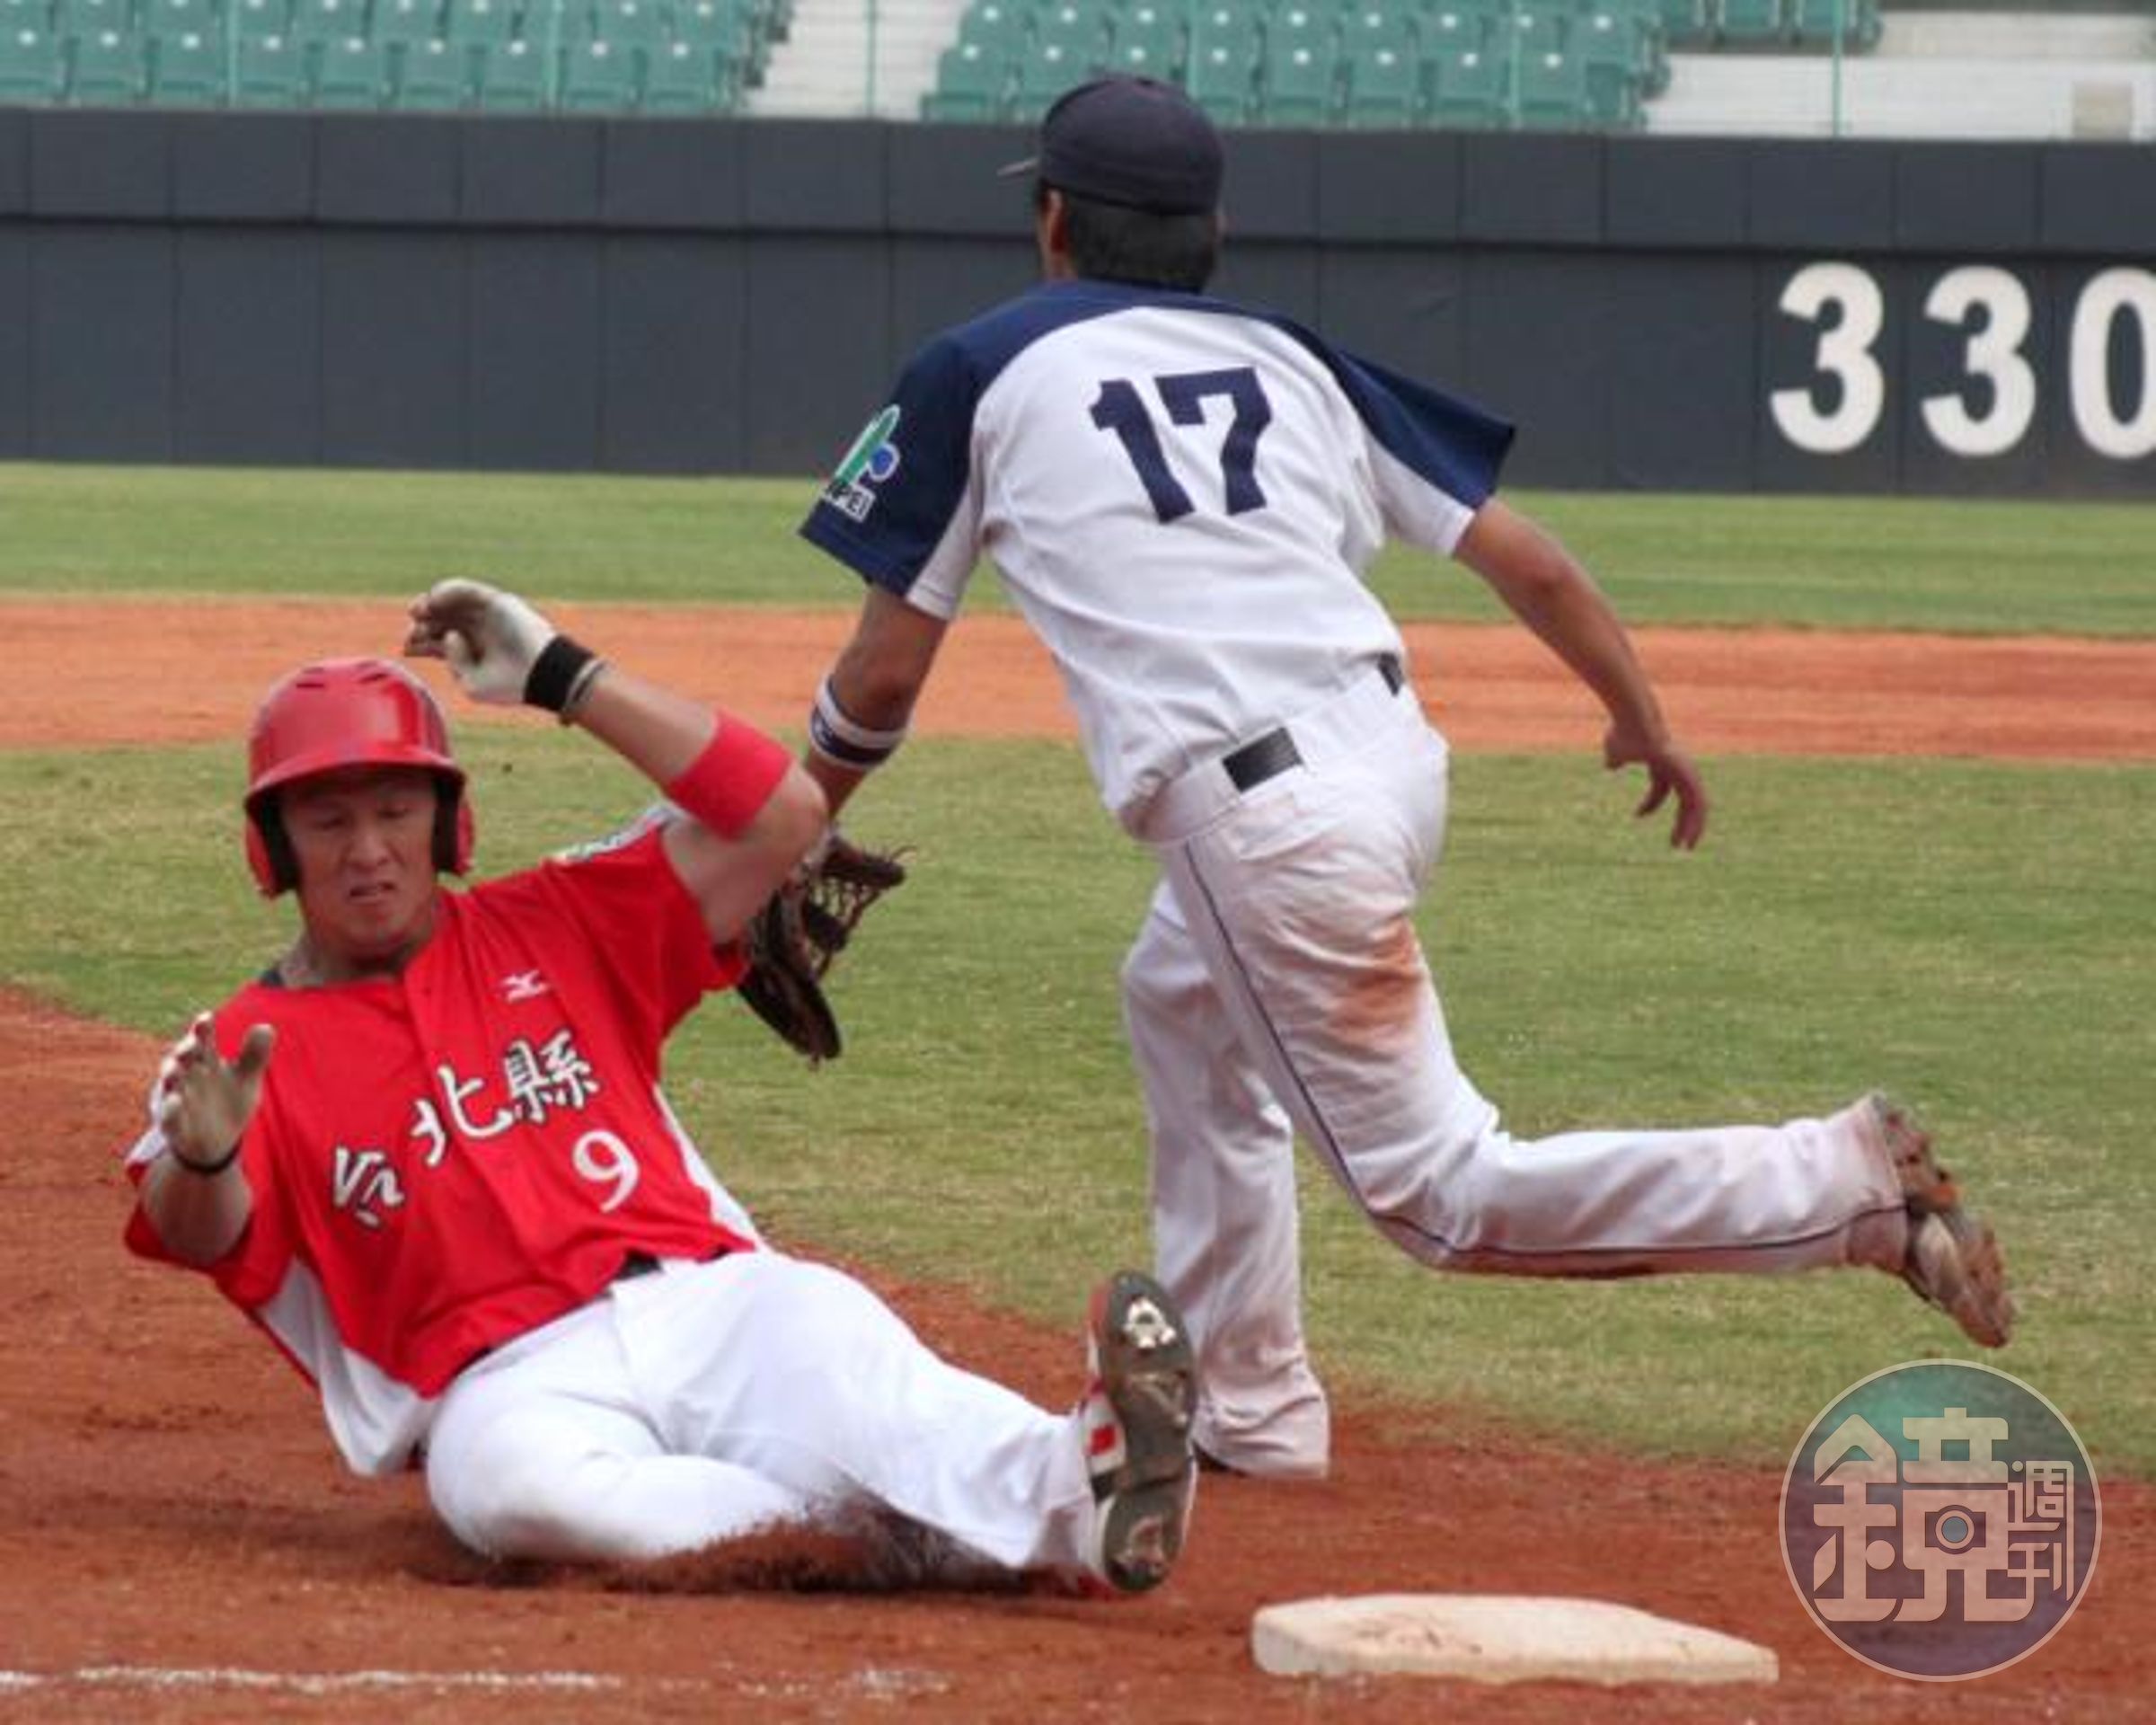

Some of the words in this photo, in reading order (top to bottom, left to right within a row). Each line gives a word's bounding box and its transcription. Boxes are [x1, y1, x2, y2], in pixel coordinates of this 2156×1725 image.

[1769, 261, 2156, 458] 330
[1089, 367, 1273, 525] 17
[572, 1129, 640, 1213] 9
